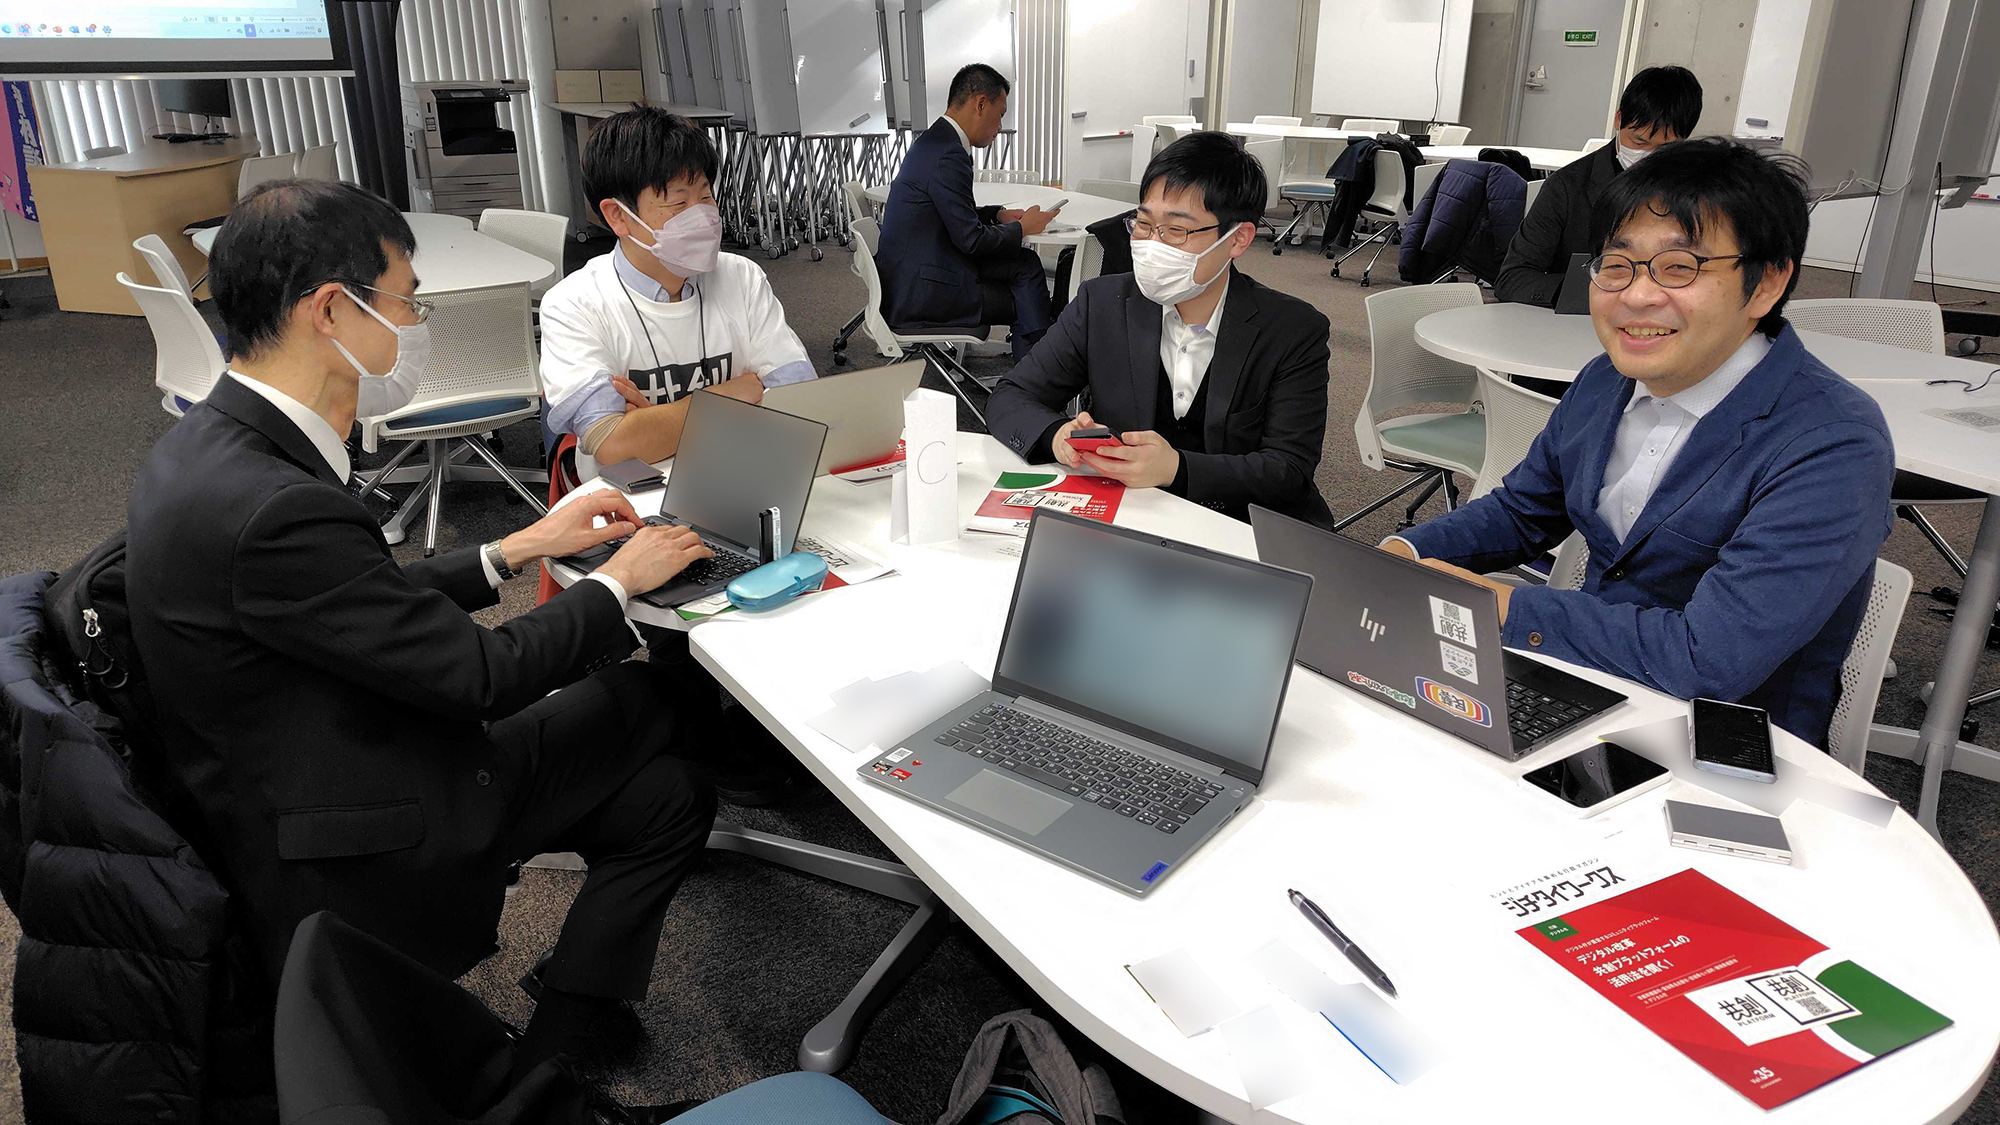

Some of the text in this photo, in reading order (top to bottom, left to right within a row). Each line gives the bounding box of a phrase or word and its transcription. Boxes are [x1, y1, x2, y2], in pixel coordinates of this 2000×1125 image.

[917, 440, 948, 485] C
[1440, 619, 1468, 643] 共創
[1439, 689, 1467, 713] 民藝
[1500, 866, 1627, 918] ジチタイワークス
[1576, 938, 1637, 965] デジタル改革
[1592, 934, 1691, 977] 共創プラットフォームの
[1766, 974, 1810, 997] 共創
[1783, 990, 1817, 1002] PLATFORM
[1717, 993, 1768, 1022] 共創
[1737, 1012, 1777, 1028] PLATFORM
